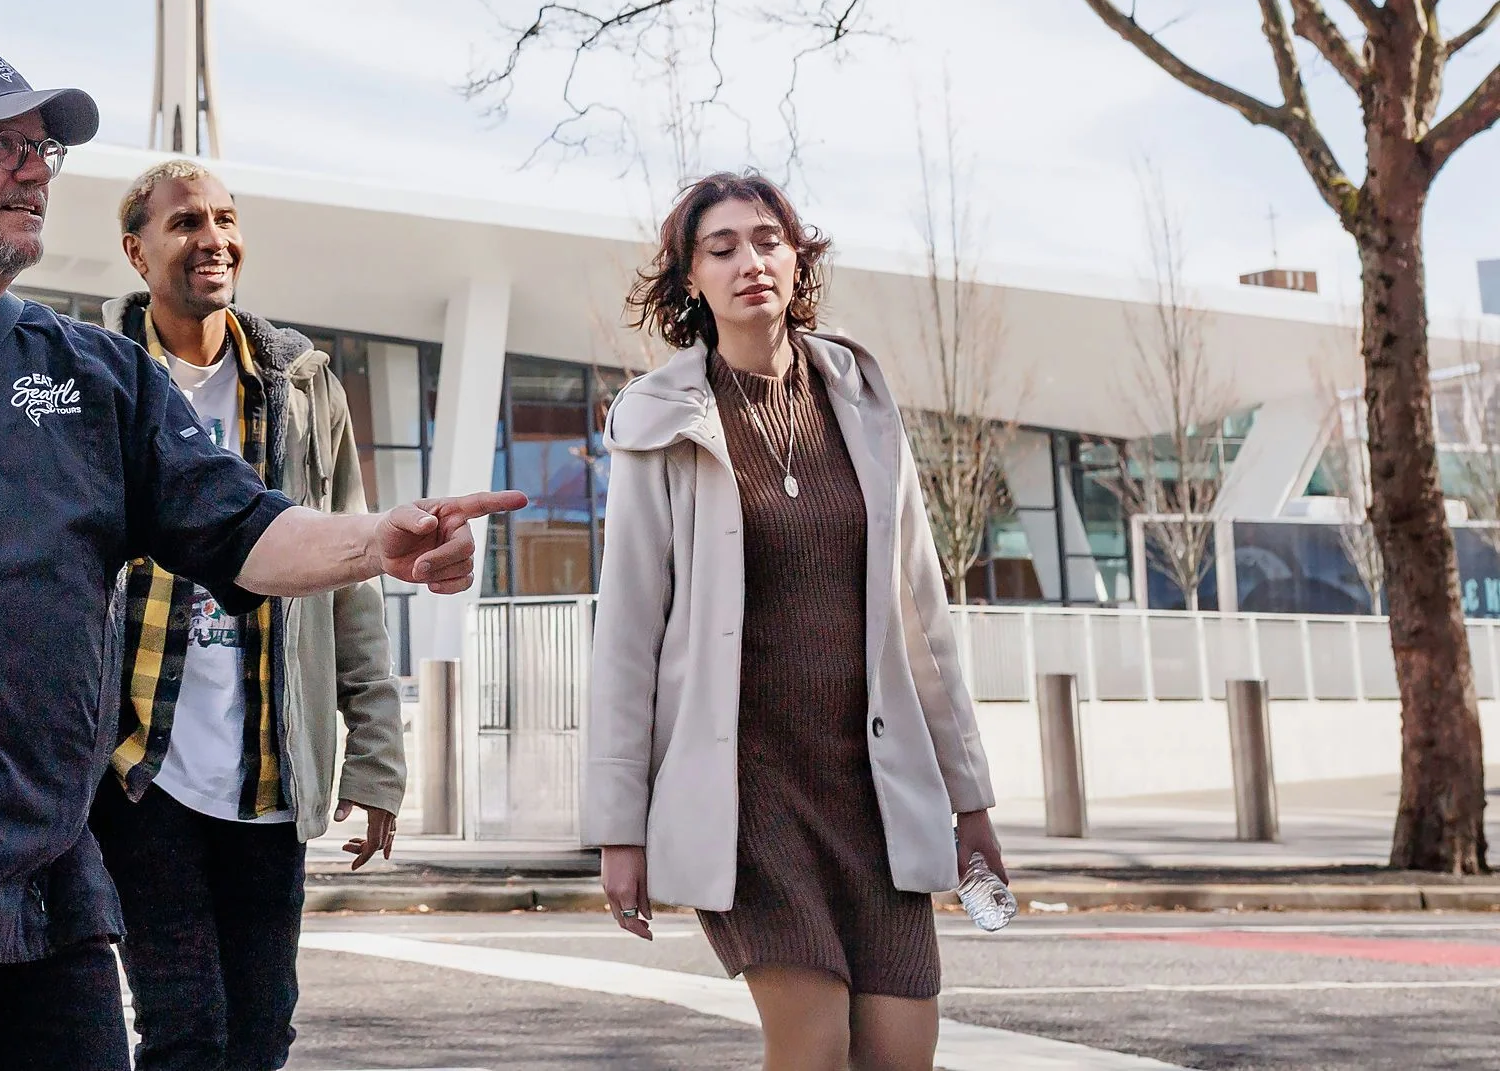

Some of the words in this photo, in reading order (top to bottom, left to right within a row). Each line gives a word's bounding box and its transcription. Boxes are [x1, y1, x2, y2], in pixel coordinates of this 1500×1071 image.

[32, 373, 53, 388] EAT
[10, 376, 81, 408] Seattle
[55, 406, 82, 415] TOURS
